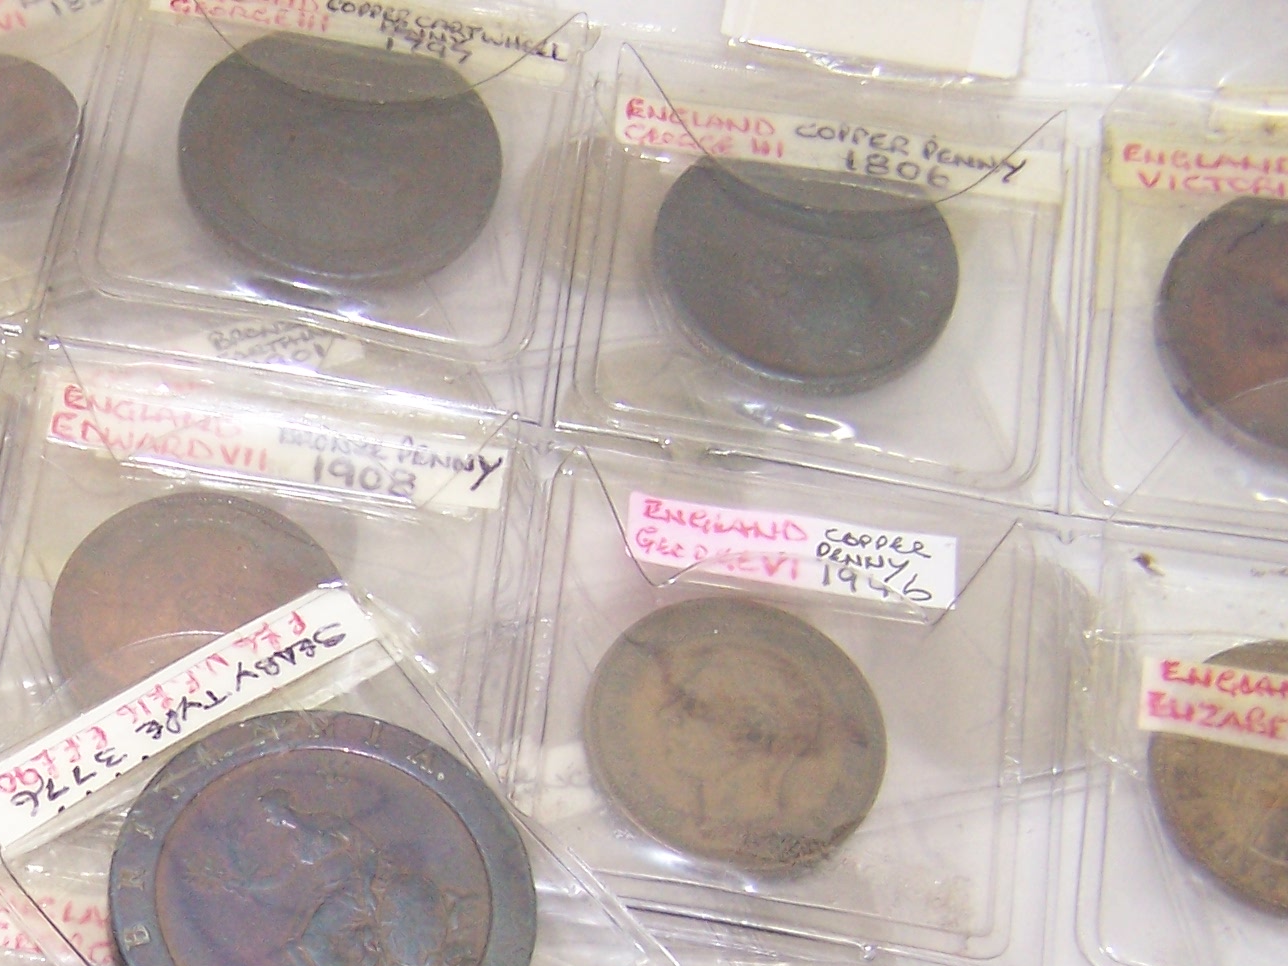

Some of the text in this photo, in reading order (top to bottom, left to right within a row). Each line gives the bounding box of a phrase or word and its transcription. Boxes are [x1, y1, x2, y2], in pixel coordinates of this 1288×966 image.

[325, 0, 568, 63] COPPER CARTWHEEL
[624, 96, 1028, 184] ENGLAND COPPER PENNY
[842, 149, 952, 190] 1806
[219, 444, 269, 473] VII
[394, 435, 505, 493] PENNY
[643, 498, 933, 560] ENGLAND COPPER
[815, 540, 910, 584] PENNY
[817, 564, 934, 603] 1946
[235, 622, 348, 692] SEABY
[134, 688, 233, 740] TYPE
